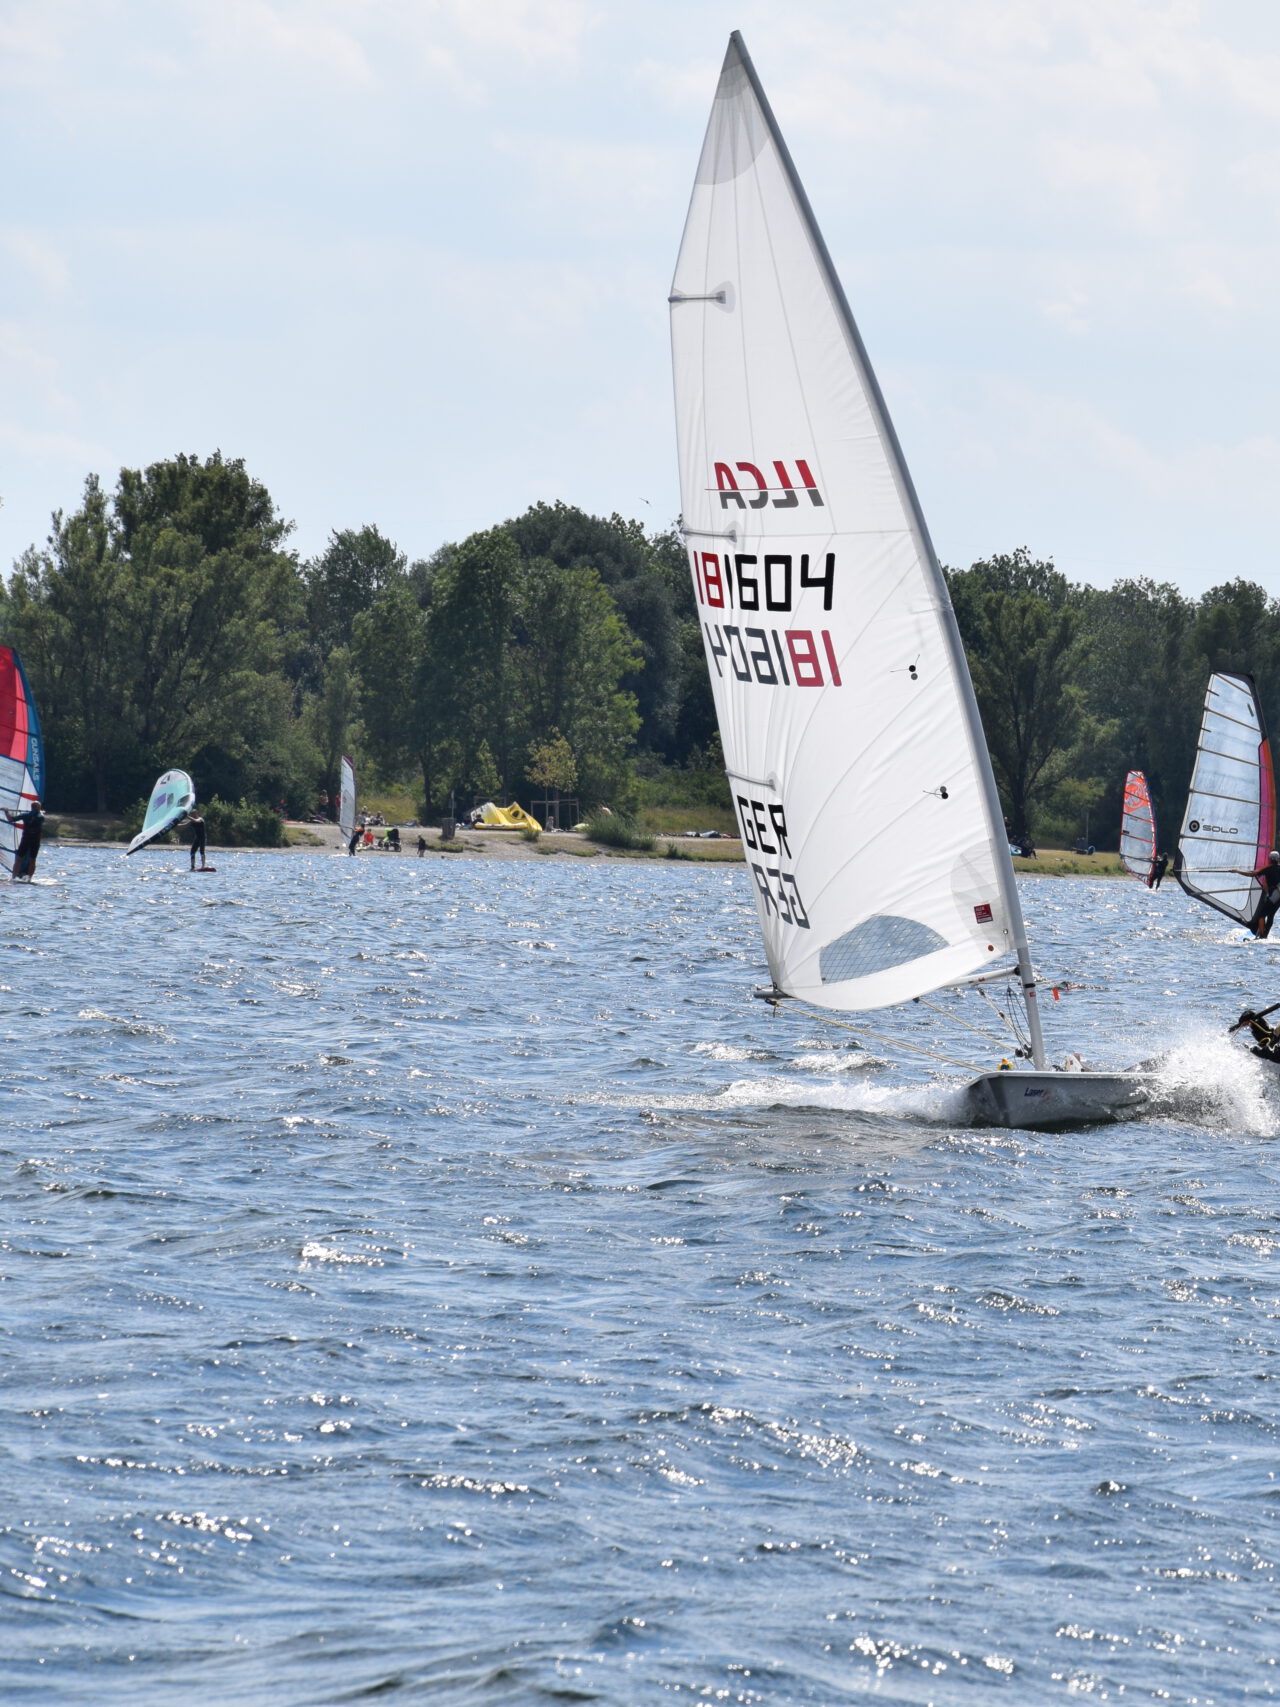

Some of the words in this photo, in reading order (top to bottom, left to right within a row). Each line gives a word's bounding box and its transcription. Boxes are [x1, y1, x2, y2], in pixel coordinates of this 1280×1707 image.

[693, 550, 836, 612] 181604
[736, 794, 793, 860] GER
[1202, 824, 1239, 835] SOLO
